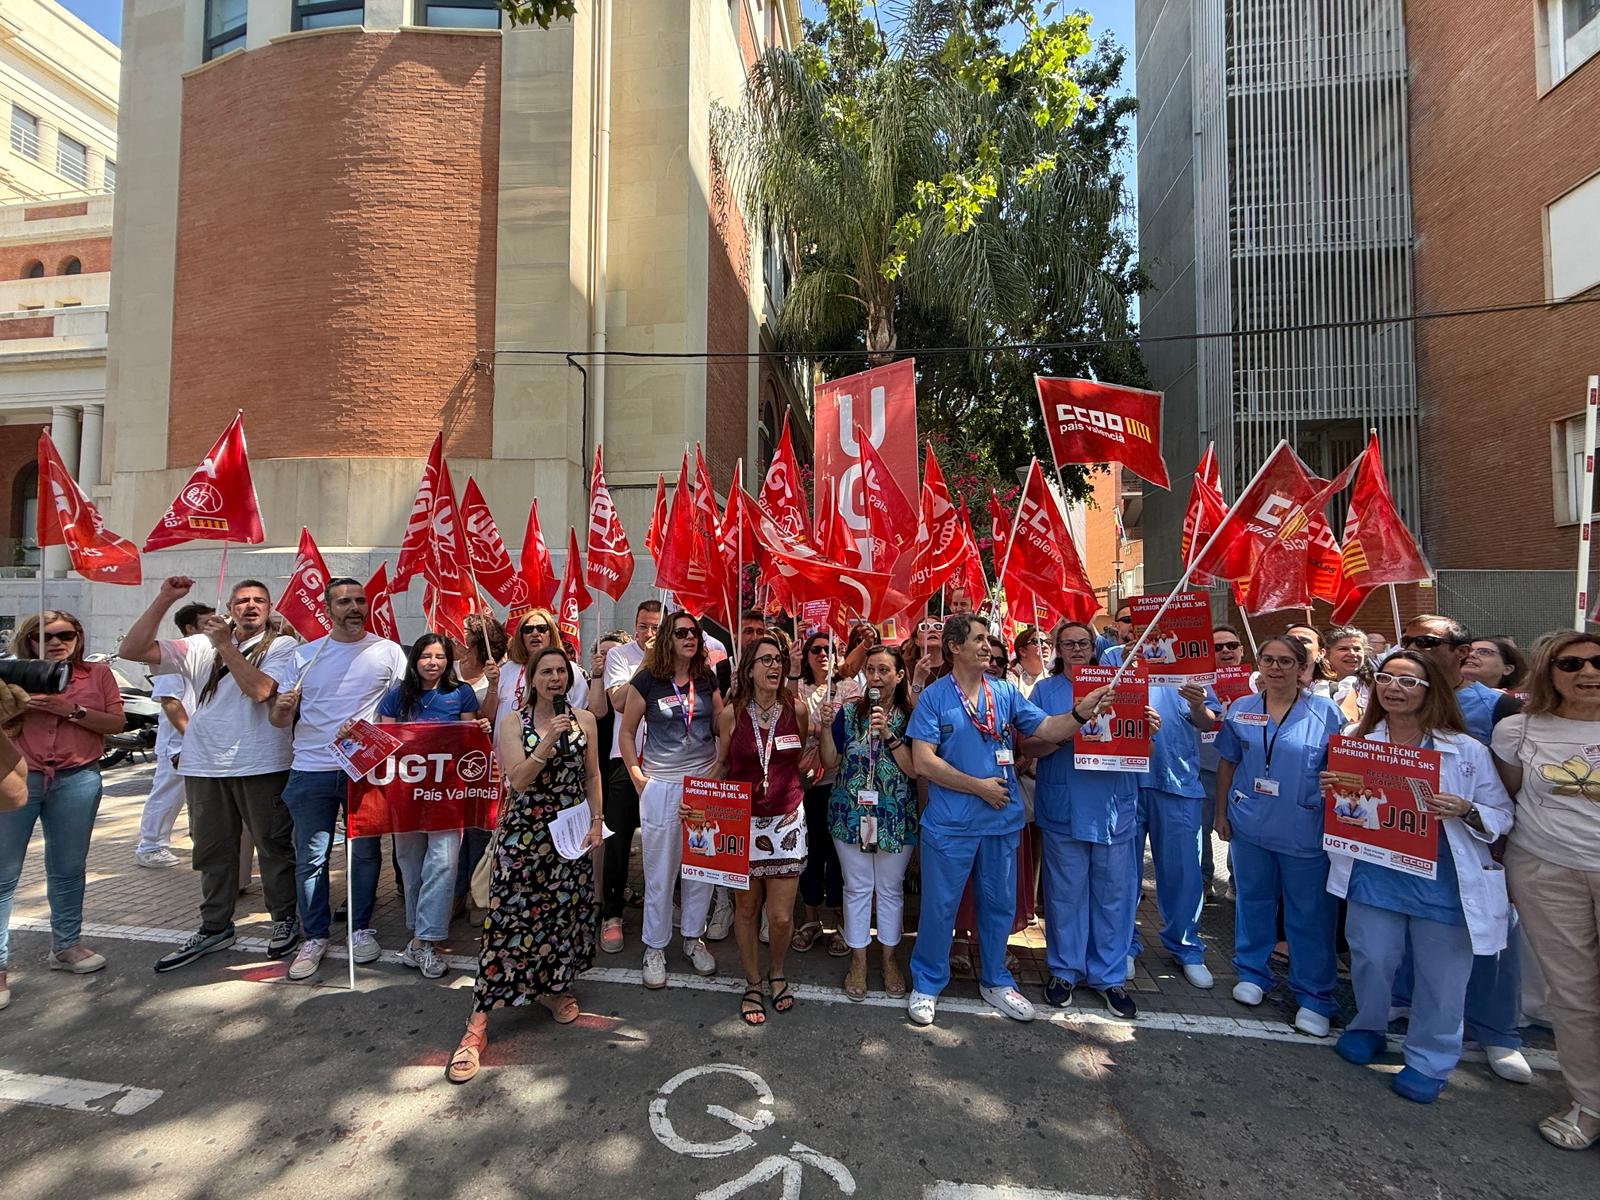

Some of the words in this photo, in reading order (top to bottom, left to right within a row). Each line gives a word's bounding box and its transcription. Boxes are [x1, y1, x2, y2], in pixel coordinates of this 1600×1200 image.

[1055, 403, 1124, 433] CCOO
[1059, 420, 1085, 435] país
[1137, 595, 1169, 605] PERSONA
[1176, 639, 1209, 659] JA!
[1081, 667, 1113, 676] PERSONAL
[1113, 718, 1143, 739] JA!
[1341, 739, 1386, 753] PERSONAL
[1389, 745, 1421, 760] TÈCNIC
[1075, 757, 1092, 765] UGT
[1332, 746, 1369, 760] SUPERIOR
[1371, 752, 1375, 760] I
[1376, 752, 1398, 765] MITJÀ
[1400, 758, 1415, 768] DEL
[1418, 761, 1435, 771] SNS
[366, 753, 453, 786] UGT
[690, 780, 719, 790] PERSONAL
[720, 781, 740, 791] TÈCNIC
[413, 788, 442, 801] País
[446, 786, 499, 800] Valencià
[1381, 806, 1428, 837] JA!
[716, 834, 745, 857] JA!
[1324, 837, 1349, 850] UGT
[1402, 856, 1432, 869] CCOO
[683, 867, 698, 876] UGT
